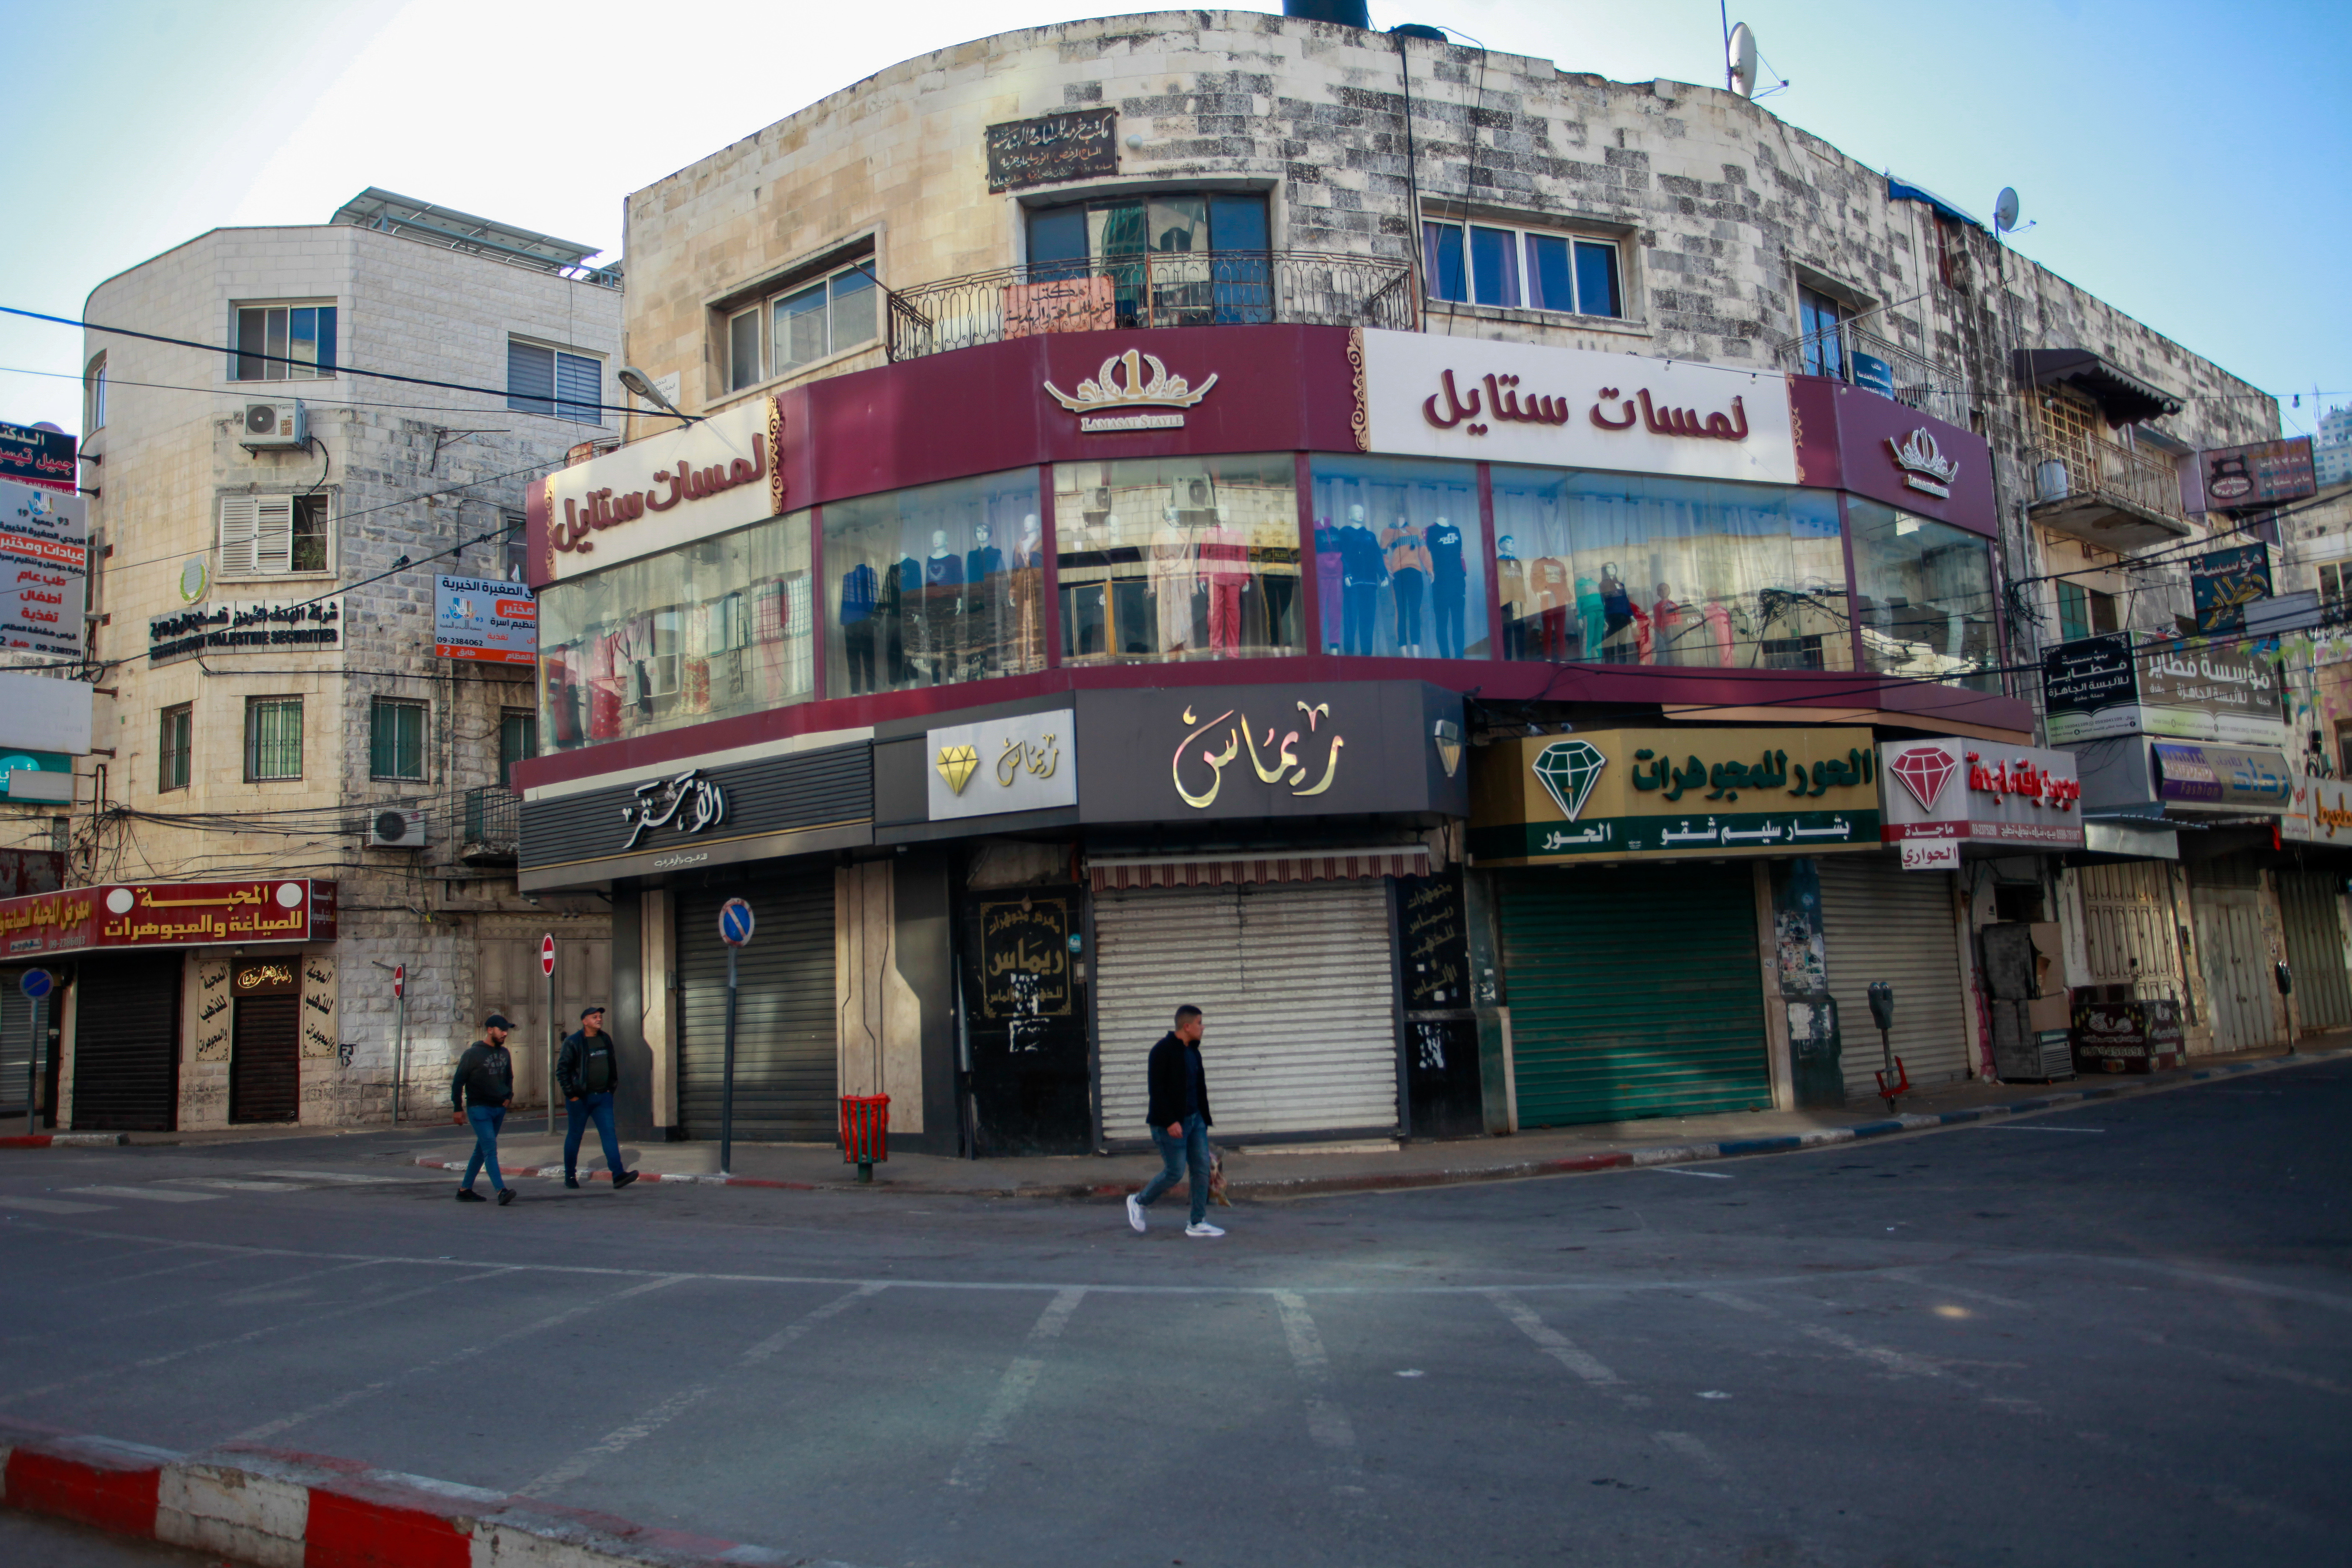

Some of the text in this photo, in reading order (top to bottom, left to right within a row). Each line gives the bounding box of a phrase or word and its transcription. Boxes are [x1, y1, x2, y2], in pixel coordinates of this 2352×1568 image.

[1079, 113, 1112, 145] مكتب
[1422, 368, 1749, 441] لمسات ستايل
[0, 424, 45, 446] الدكت
[36, 453, 74, 476] جميل
[552, 432, 767, 554] لمسات ستايل
[0, 521, 27, 533] الخيرية
[17, 508, 70, 526] 19 93
[32, 517, 55, 528] جمعية
[28, 527, 59, 540] الصغيرة
[0, 553, 14, 561] اسر
[44, 544, 85, 562] عيادات
[17, 570, 66, 586] طب عام
[442, 577, 480, 592] الخيرية
[482, 582, 523, 596] الصغيرة
[20, 589, 63, 605] أطفال
[21, 607, 59, 623] تغذية
[490, 617, 509, 628] اسرة
[0, 623, 27, 632] العظام
[207, 628, 338, 647] PALESTINE SECURITIES
[487, 632, 509, 641] تغذية
[437, 636, 484, 646] 09-2384062
[444, 646, 476, 657] 2 طابق
[506, 653, 531, 662] العظام
[2047, 660, 2128, 685] فطاير
[2147, 650, 2270, 690] مؤسسة فطاير
[2048, 682, 2087, 698] الجاهزة
[1632, 748, 1874, 803] الحور للمجوهرات
[2180, 781, 2219, 796] Fashion
[1541, 822, 1612, 850] الحور
[1660, 814, 1850, 846] بشار سليم شقو
[1904, 823, 1954, 838] ماجدة
[1902, 846, 1957, 867] الحواري
[136, 884, 270, 912] المحبة
[1407, 883, 1453, 909] مجوهرات
[32, 896, 64, 934] المحبة
[60, 896, 93, 931] معرض
[229, 910, 303, 936] للصياغة
[1409, 906, 1454, 935] ريماس
[104, 914, 227, 941] والمجوهرات
[1411, 924, 1455, 958] للذهب
[988, 937, 1064, 977] ريماس
[199, 965, 229, 992] المحبة
[306, 960, 334, 985] المحبة
[199, 994, 228, 1024] للذهب
[305, 992, 334, 1015] للذهب
[199, 1027, 228, 1053] والمجوهرات
[306, 1023, 335, 1052] والمجوهرات
